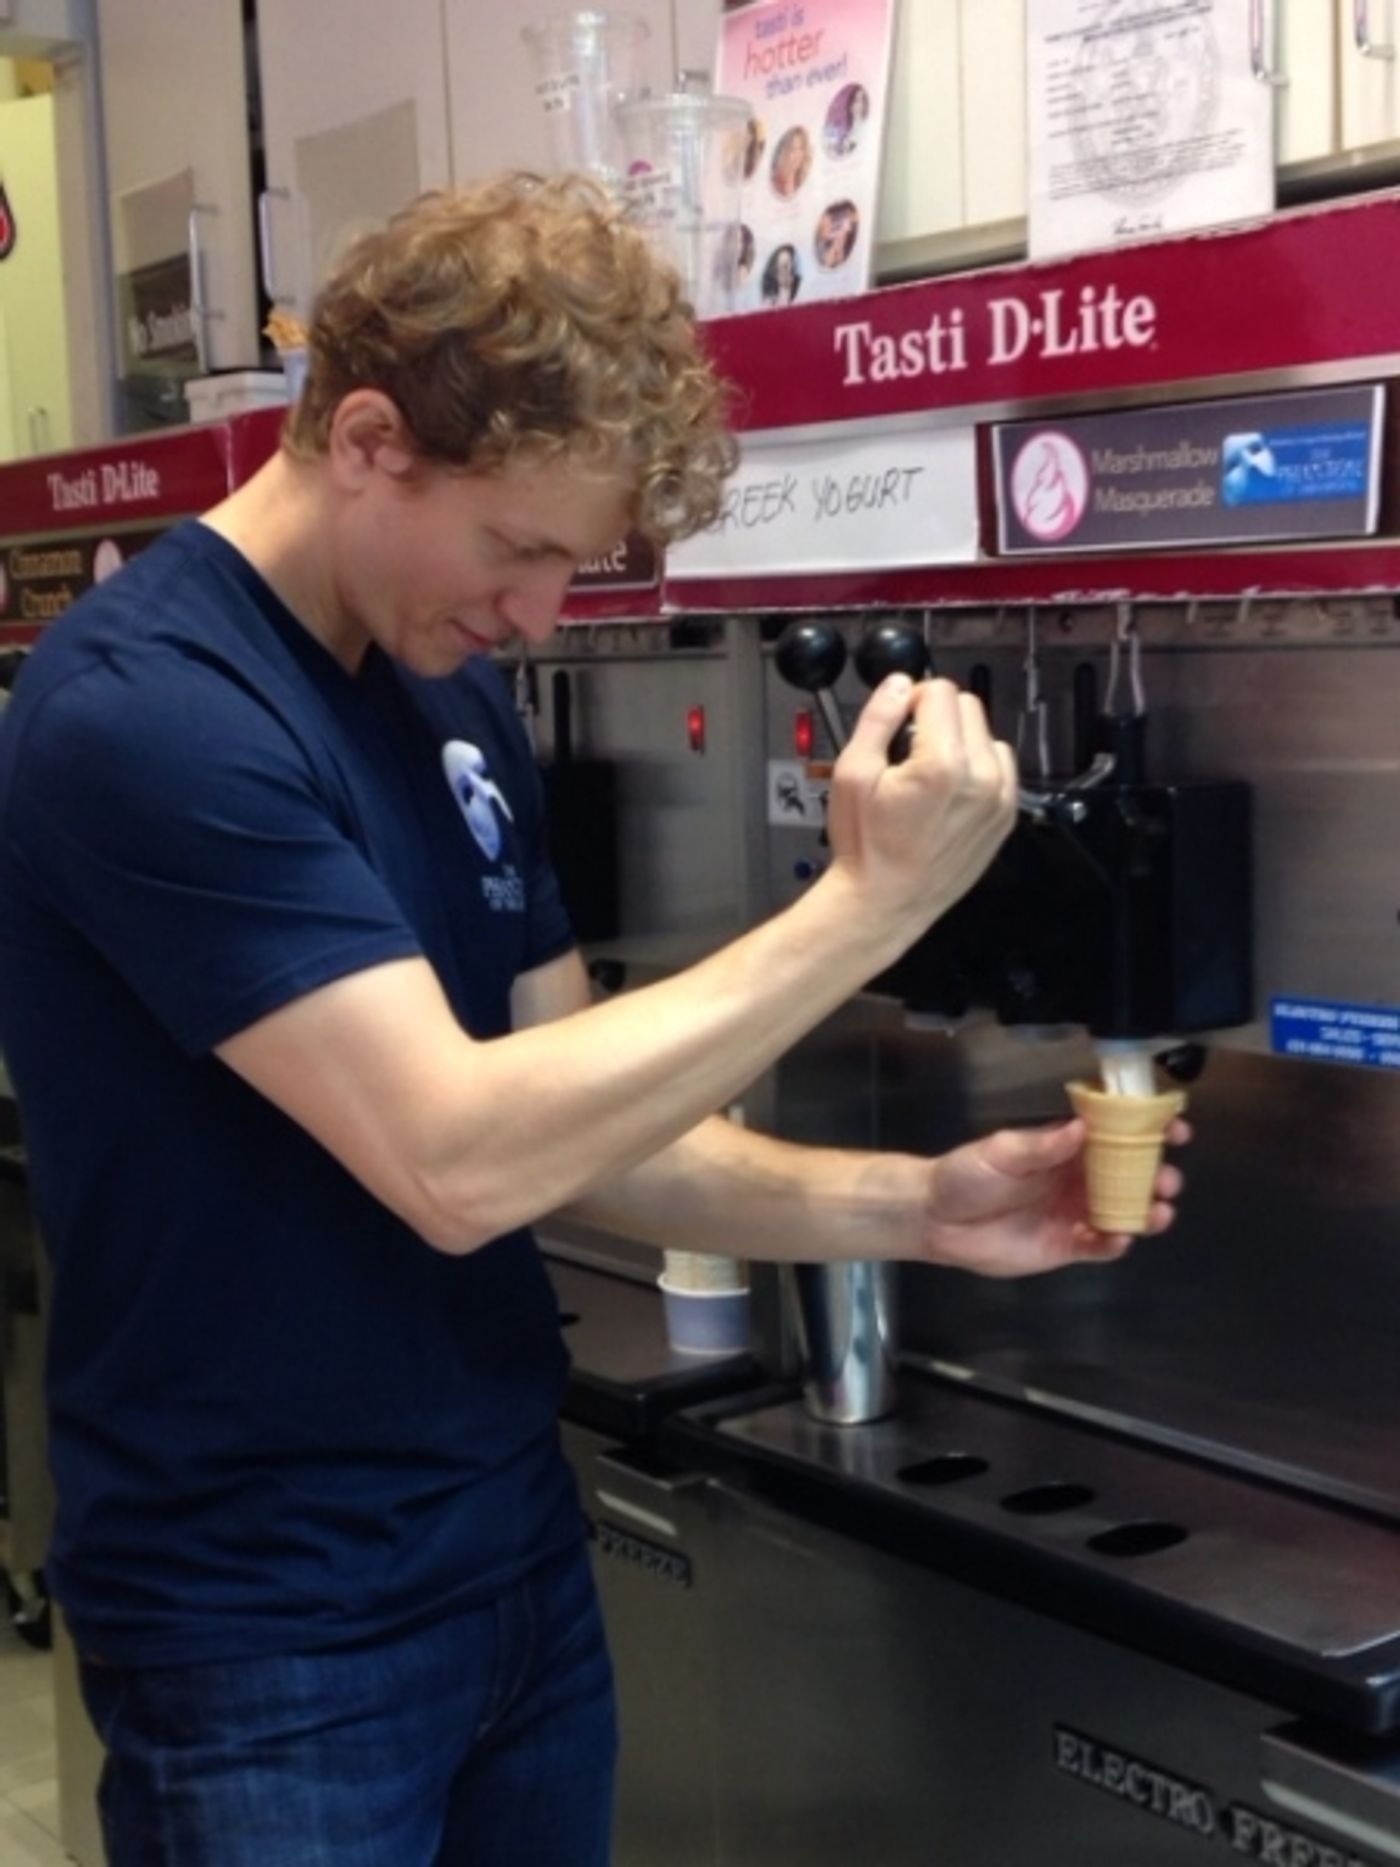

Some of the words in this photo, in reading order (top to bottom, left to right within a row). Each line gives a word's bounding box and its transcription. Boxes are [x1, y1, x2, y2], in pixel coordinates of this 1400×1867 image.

[755, 6, 788, 40] tasti
[790, 4, 805, 26] is
[743, 28, 825, 80] hotter
[766, 74, 802, 100] than
[806, 52, 847, 88] ever!
[834, 307, 967, 386] Tasti
[1092, 441, 1218, 475] Marshmallow
[47, 469, 97, 511] Tasti
[810, 466, 925, 523] YOGURT
[1095, 480, 1217, 517] Masquerade
[1055, 1731, 1215, 1836] ELECTRO
